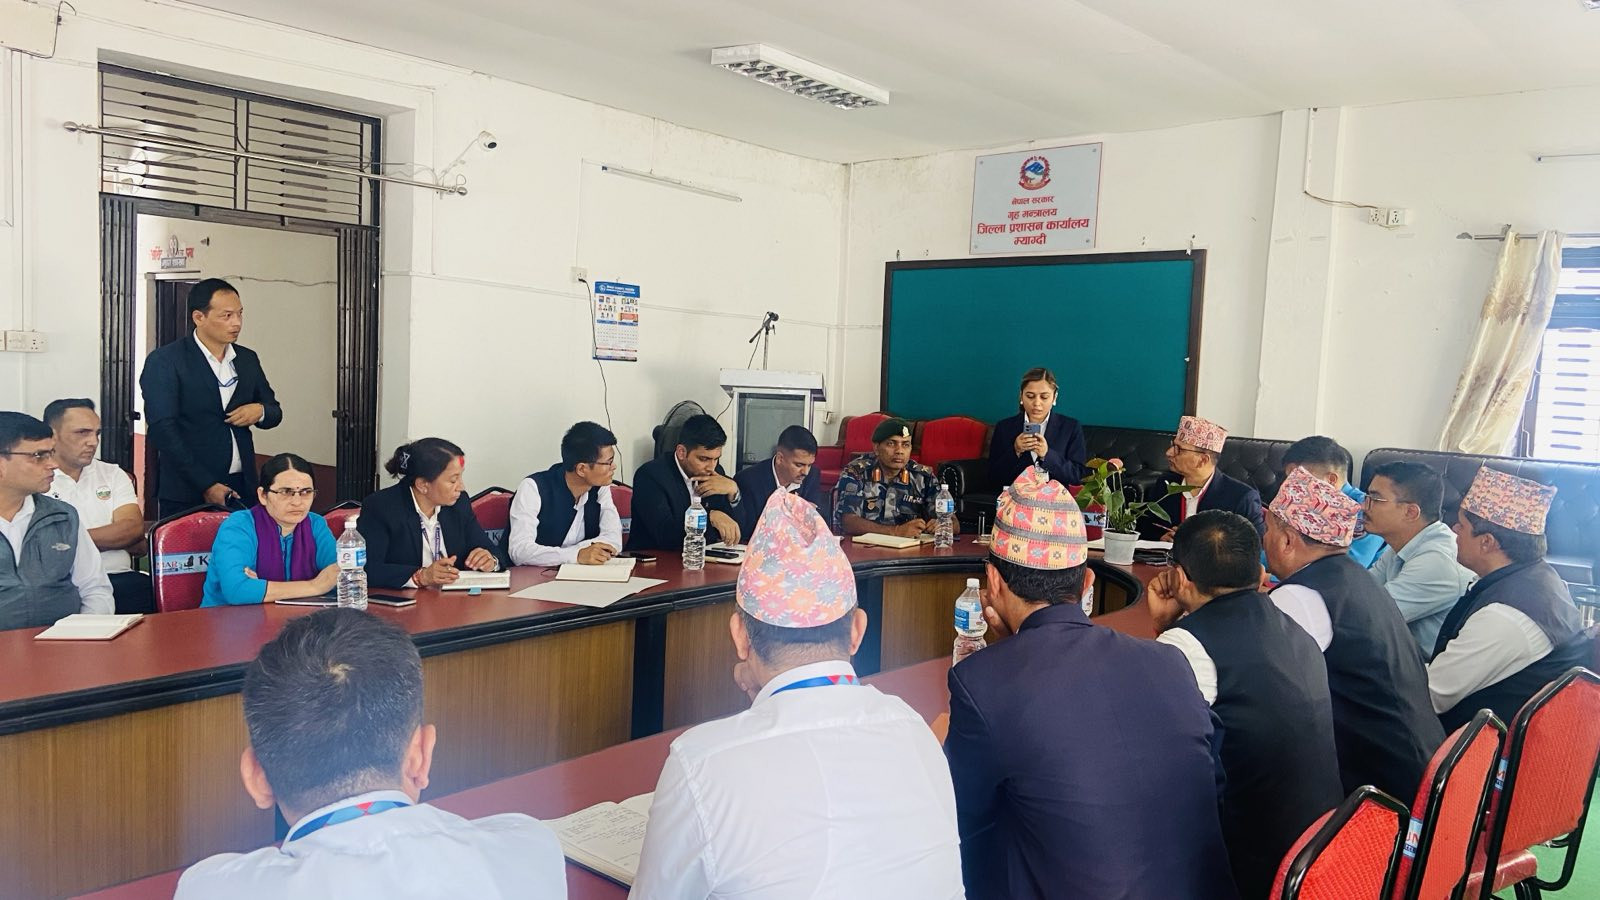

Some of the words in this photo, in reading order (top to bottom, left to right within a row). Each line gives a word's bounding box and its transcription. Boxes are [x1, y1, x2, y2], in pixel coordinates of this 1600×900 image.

[1012, 196, 1030, 205] नेपाल
[1031, 195, 1055, 204] सरकार
[1007, 210, 1020, 221] गृह
[1022, 208, 1058, 218] मन्त्रालय
[977, 223, 1006, 234] जिल्ला
[1009, 221, 1044, 233] प्रशासन
[1046, 217, 1090, 230] कार्यालय
[1014, 232, 1047, 245] म्याग्दी
